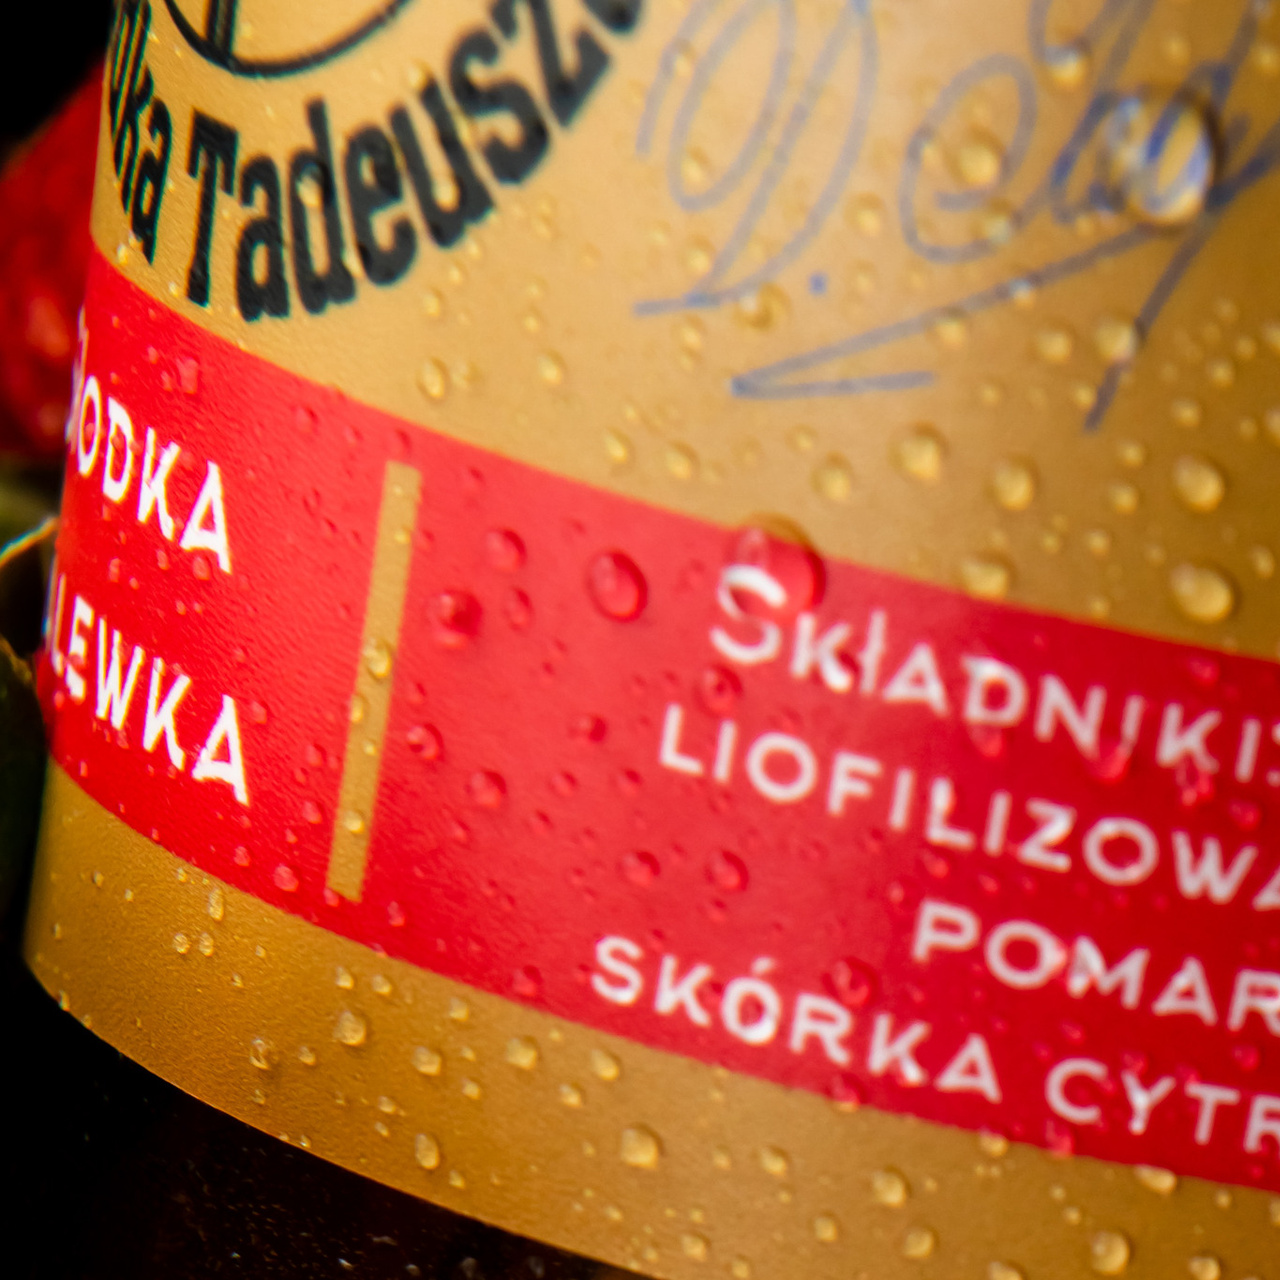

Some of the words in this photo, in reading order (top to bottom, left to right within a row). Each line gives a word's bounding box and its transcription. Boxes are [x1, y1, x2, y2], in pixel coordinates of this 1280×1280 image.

[186, 0, 642, 323] Tadeusz
[65, 306, 231, 574] ODKA
[44, 565, 248, 806] LEWKA
[591, 936, 1001, 1102] SKÓRKA
